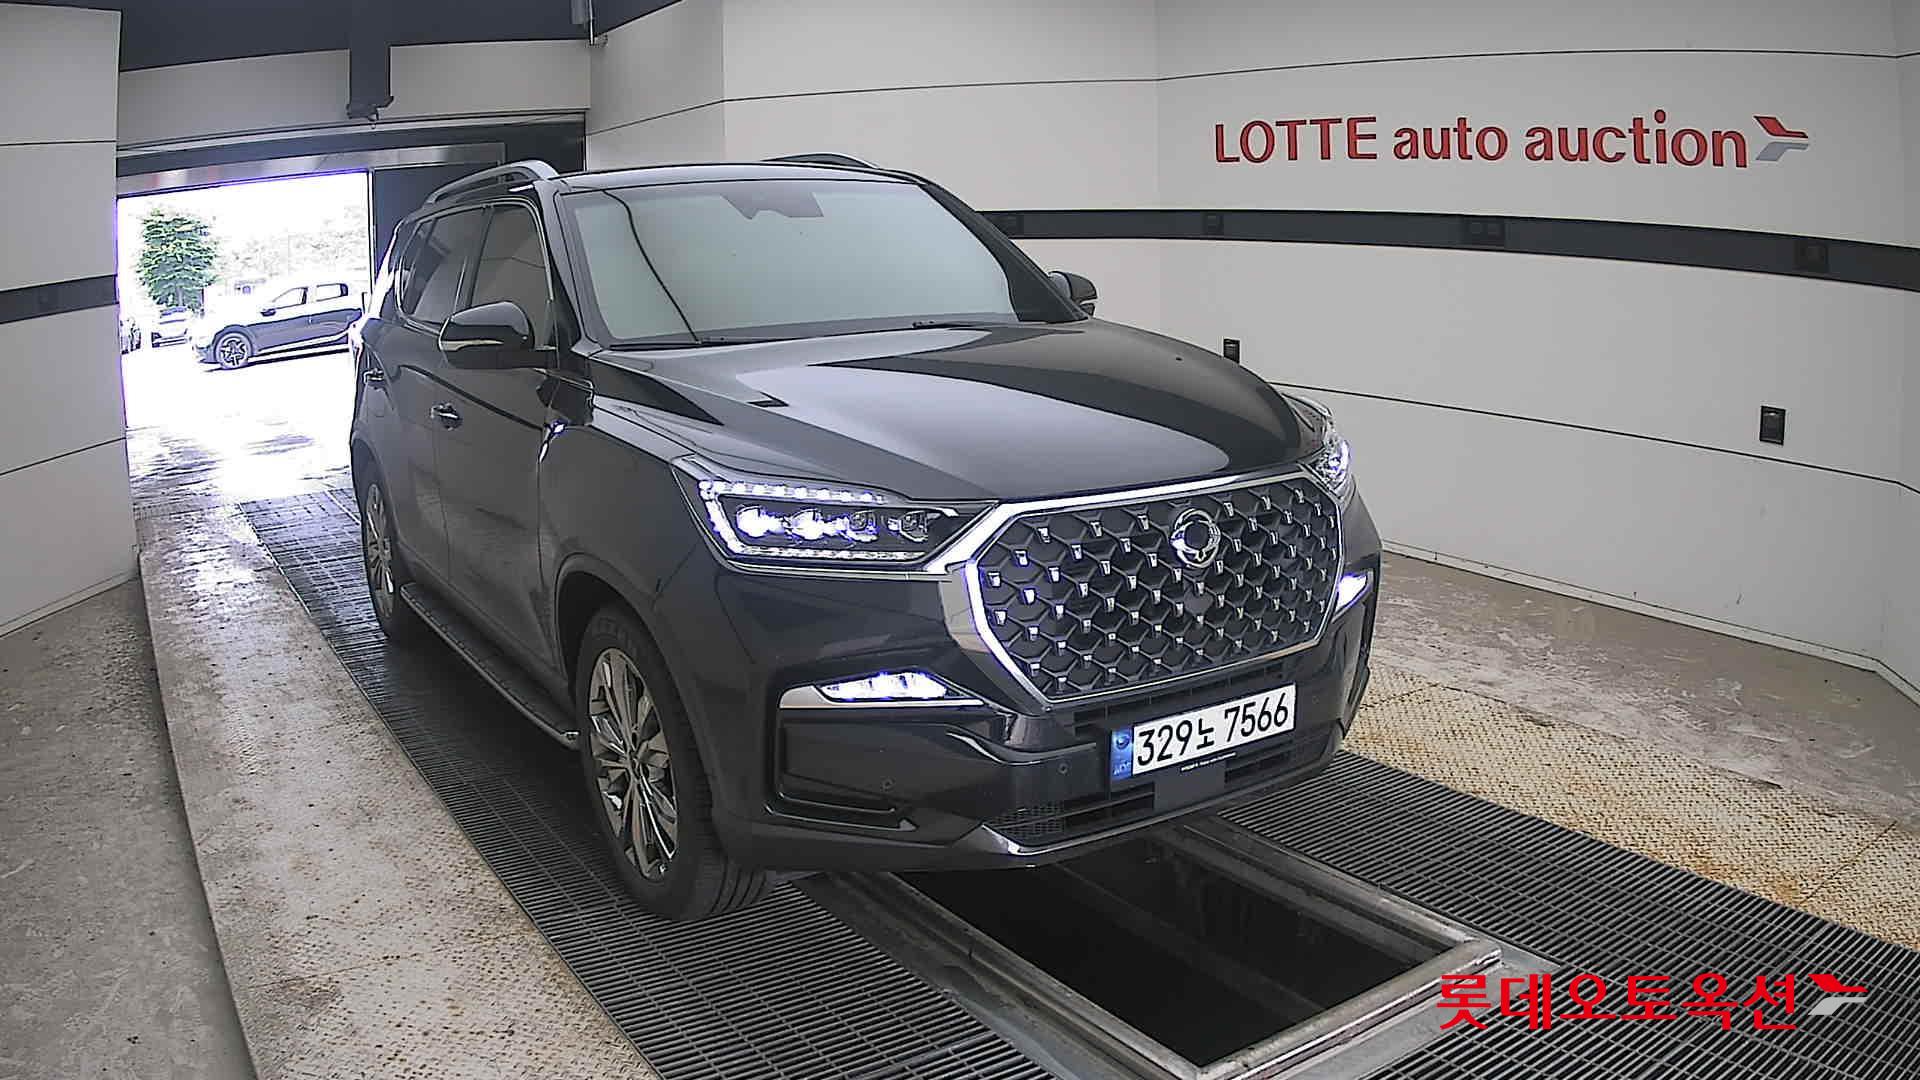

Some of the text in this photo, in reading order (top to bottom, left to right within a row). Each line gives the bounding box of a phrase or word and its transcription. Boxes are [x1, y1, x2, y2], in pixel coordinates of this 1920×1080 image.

[1214, 109, 1748, 168] LOTTE auto auction
[1137, 718, 1215, 766] 329노
[1224, 692, 1289, 742] 7566
